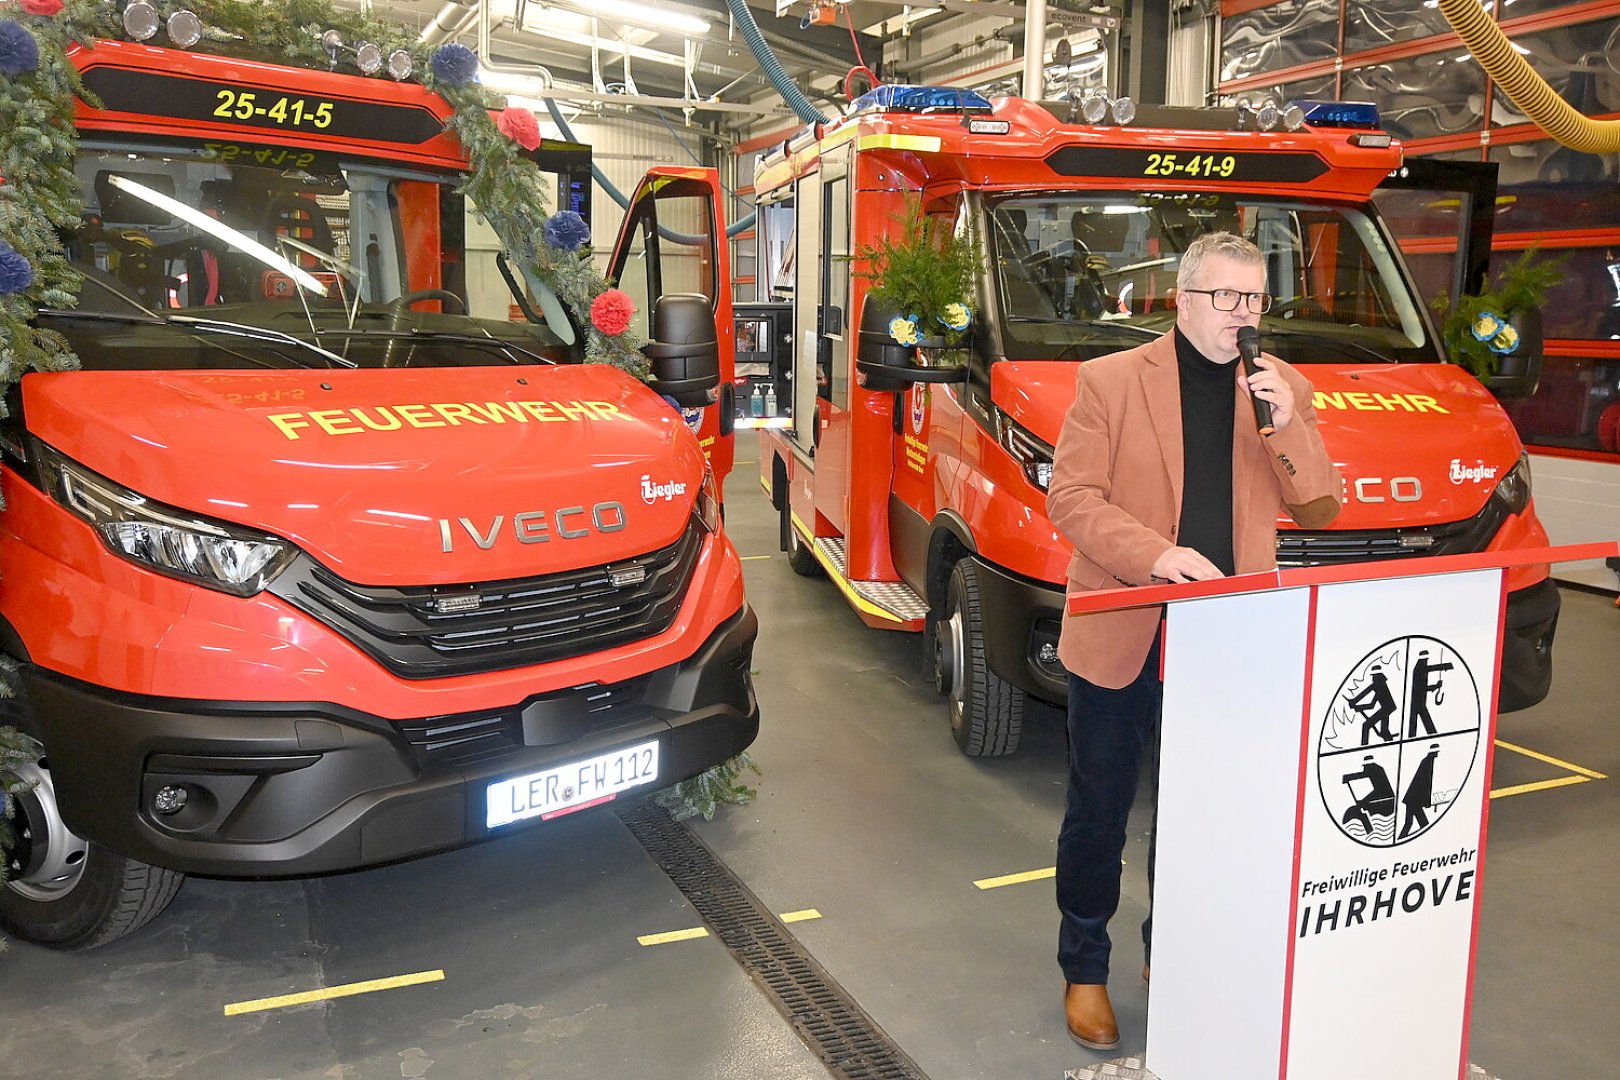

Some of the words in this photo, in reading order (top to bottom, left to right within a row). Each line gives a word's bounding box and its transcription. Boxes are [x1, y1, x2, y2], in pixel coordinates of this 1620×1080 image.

[1051, 12, 1086, 23] ecovent
[213, 90, 334, 129] 25-41-5
[1143, 153, 1236, 177] 25-41-9
[267, 401, 634, 440] FEUERWEHR
[641, 474, 687, 505] Ziegler
[1449, 458, 1497, 485] Ziegler
[438, 501, 627, 553] IVECO
[511, 774, 559, 814] LER
[578, 761, 607, 796] FW
[614, 748, 653, 786] 112
[1302, 868, 1388, 898] Freiwillige
[1391, 847, 1476, 878] Feuerwehr
[1299, 869, 1475, 938] IHRHOVE
